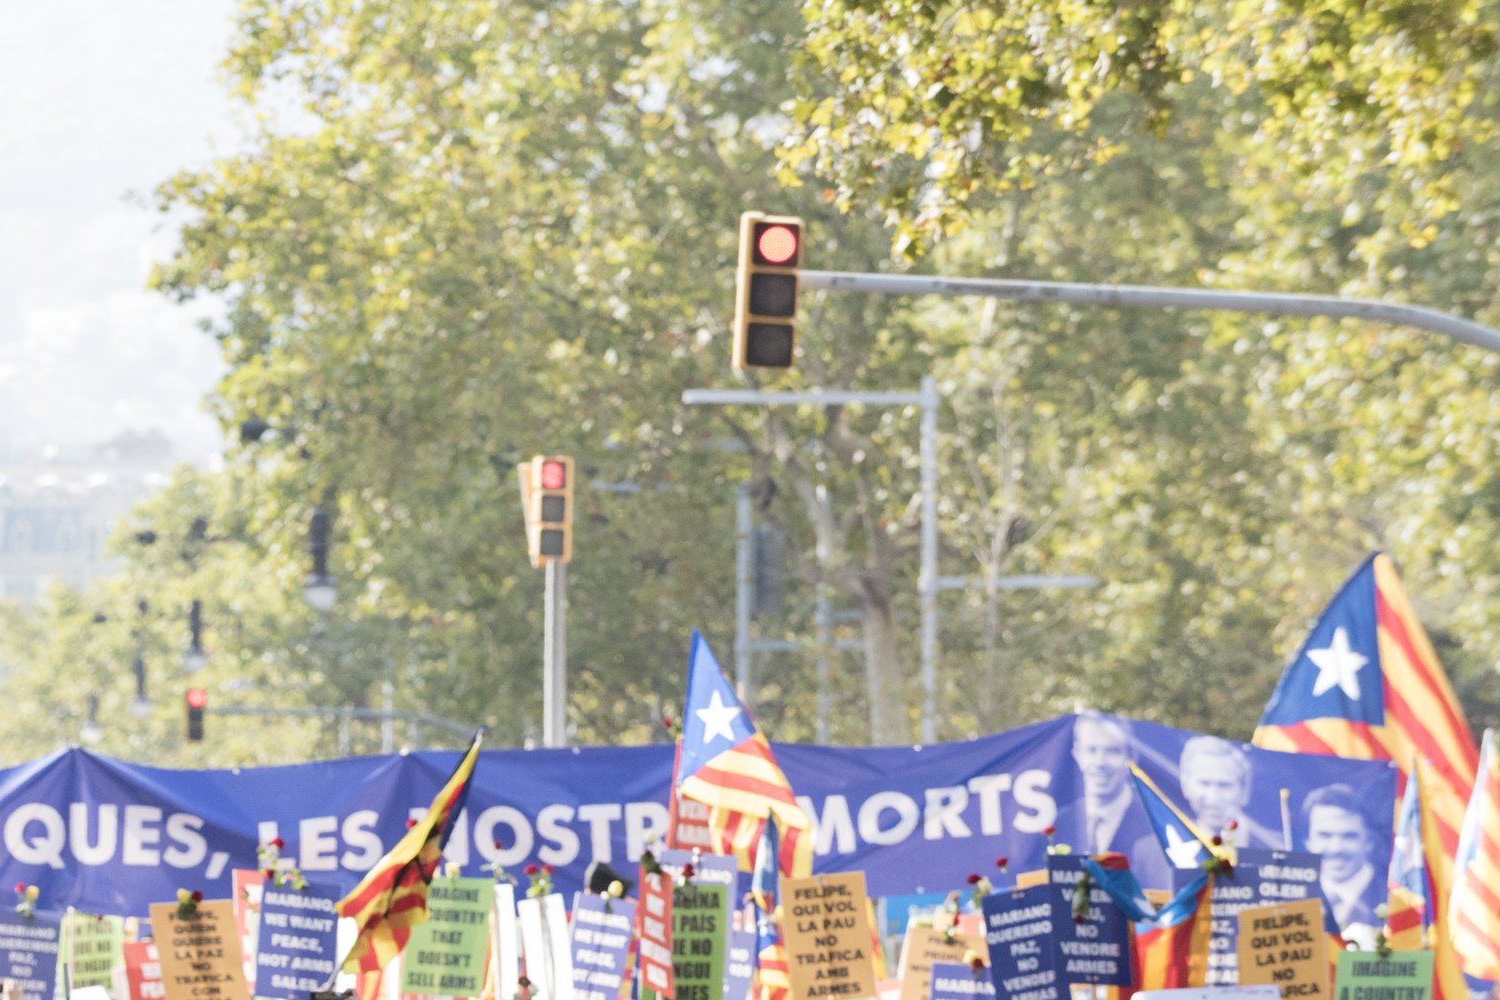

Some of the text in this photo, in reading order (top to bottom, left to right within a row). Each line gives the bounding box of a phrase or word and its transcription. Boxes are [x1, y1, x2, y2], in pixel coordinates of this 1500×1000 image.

[258, 809, 383, 872] LES
[797, 768, 1057, 857] MORTS
[1259, 864, 1318, 882] RIANO
[431, 887, 479, 903] MAGINE
[794, 885, 853, 900] FELIPE,
[1213, 886, 1254, 900] IANO
[1259, 882, 1307, 898] OLEM
[265, 891, 337, 914] MARIANO,
[793, 901, 856, 917] QUI VOL
[264, 912, 334, 933] WE WANT
[430, 908, 484, 924] OUNTRY
[681, 913, 716, 933] PAÍS
[990, 903, 1052, 927] MARIANO
[1252, 912, 1309, 931] FELIPE,
[797, 917, 855, 933] LA PAU
[987, 920, 1053, 945] QUEREMO
[1075, 924, 1098, 938] NO
[271, 933, 323, 953] PEACE,
[432, 929, 463, 944] THAT
[815, 936, 838, 947] NO
[1251, 931, 1313, 949] QUI VOL
[691, 939, 712, 956] NO
[1010, 939, 1041, 956] PAZ,
[1060, 941, 1121, 957] VENDRE
[258, 952, 334, 974] NOT ARMS
[418, 951, 471, 967] DOESN'T
[795, 949, 864, 966] TRAFICA
[1017, 957, 1039, 972] NO
[1256, 948, 1312, 967] LA PAU
[11, 964, 33, 978] NO
[191, 962, 211, 971] NO
[673, 962, 710, 979] NGUI
[815, 967, 848, 980] AMB
[1066, 959, 1118, 975] ARMES
[1272, 968, 1294, 981] NO
[1352, 960, 1417, 978] IMAGINE
[408, 971, 476, 990] SELL ARMS
[806, 982, 861, 997] ARMES
[1281, 983, 1320, 999] FICA
